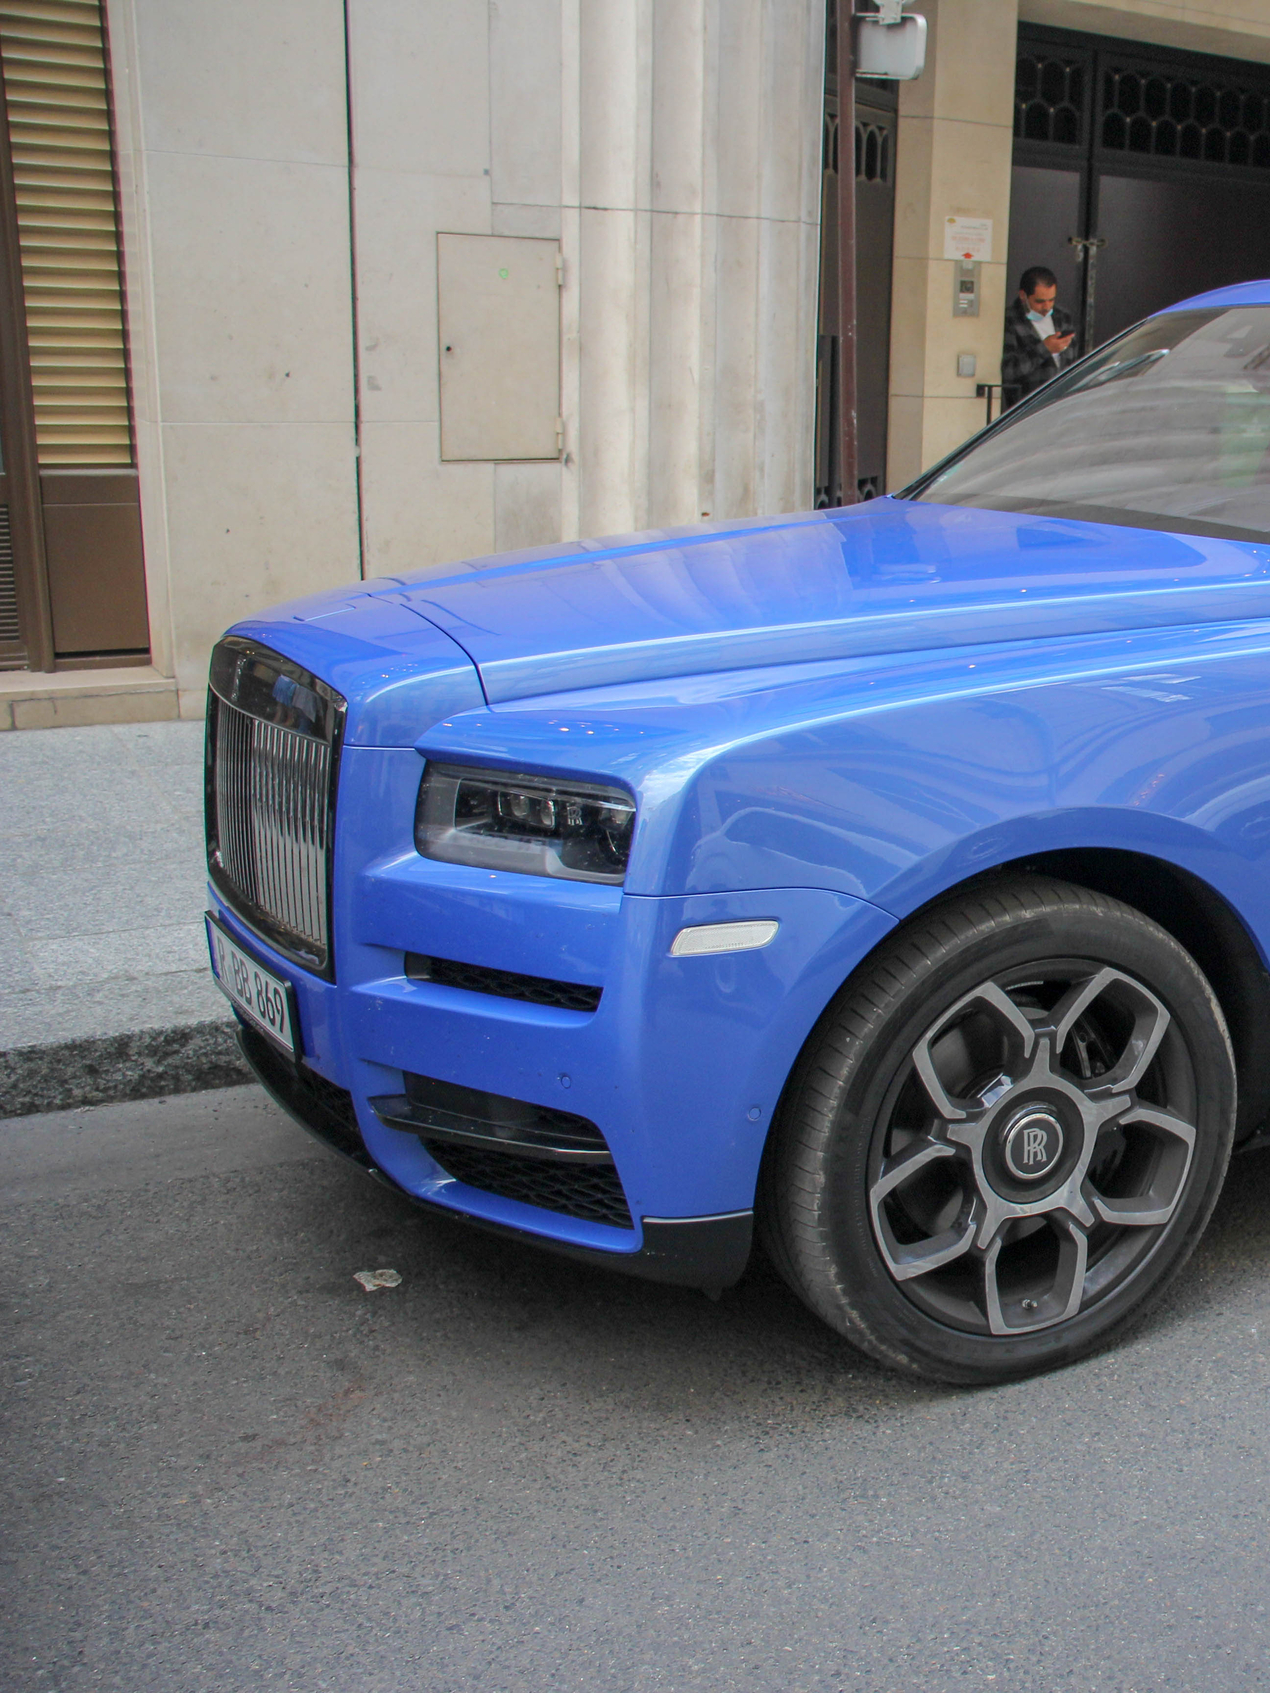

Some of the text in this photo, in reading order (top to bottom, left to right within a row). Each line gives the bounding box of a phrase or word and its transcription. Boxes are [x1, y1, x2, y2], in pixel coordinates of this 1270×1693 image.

[231, 950, 252, 1005] BB
[255, 971, 285, 1034] 869
[1023, 1127, 1048, 1165] RR
